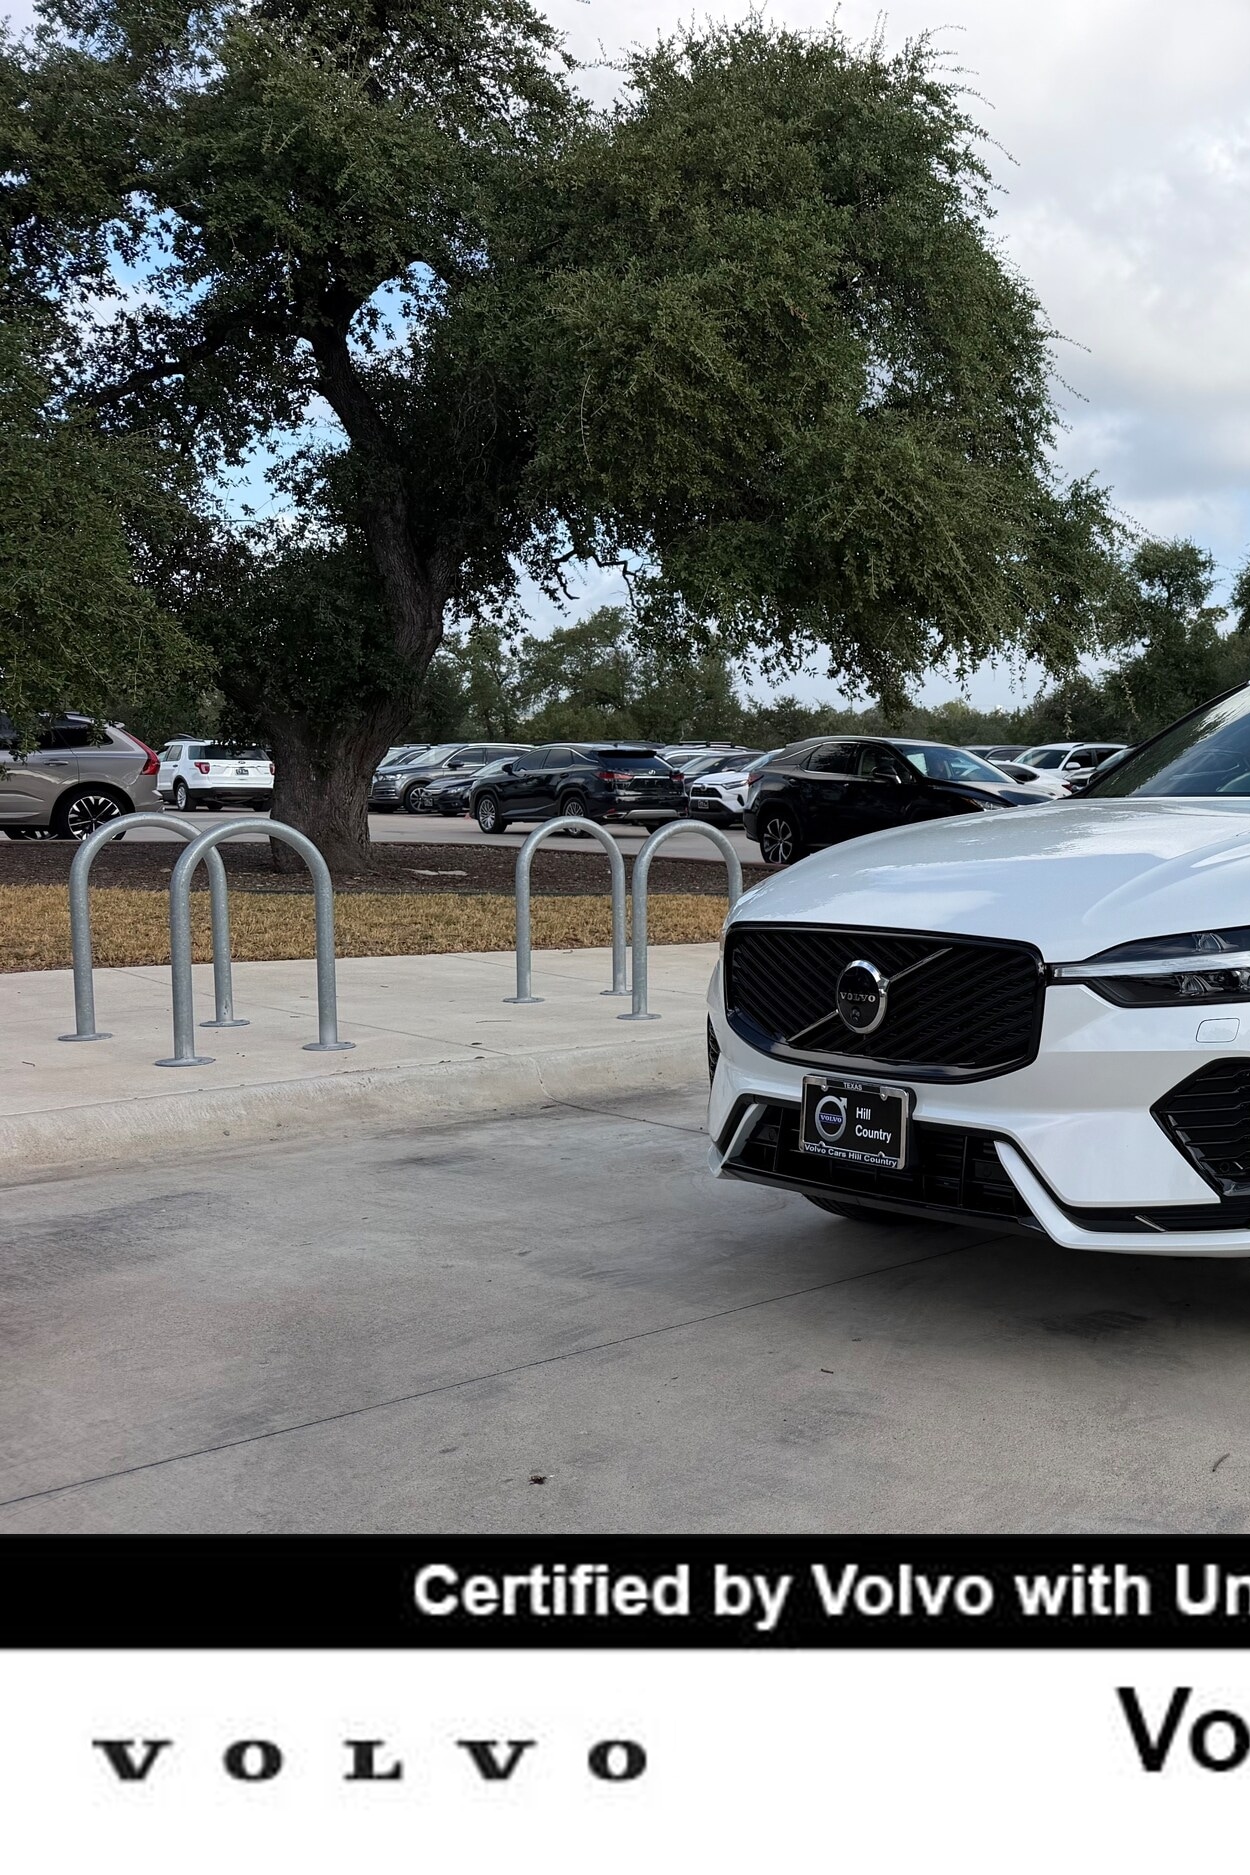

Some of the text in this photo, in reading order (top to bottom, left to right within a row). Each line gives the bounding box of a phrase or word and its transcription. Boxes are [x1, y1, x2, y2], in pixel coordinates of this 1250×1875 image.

[839, 991, 876, 1003] VOLVO
[843, 1082, 862, 1091] TEXAS
[820, 1114, 842, 1123] VOLVO
[856, 1107, 871, 1120] Hill
[855, 1124, 892, 1144] Country
[804, 1144, 898, 1168] Volvo Cars Hill Country
